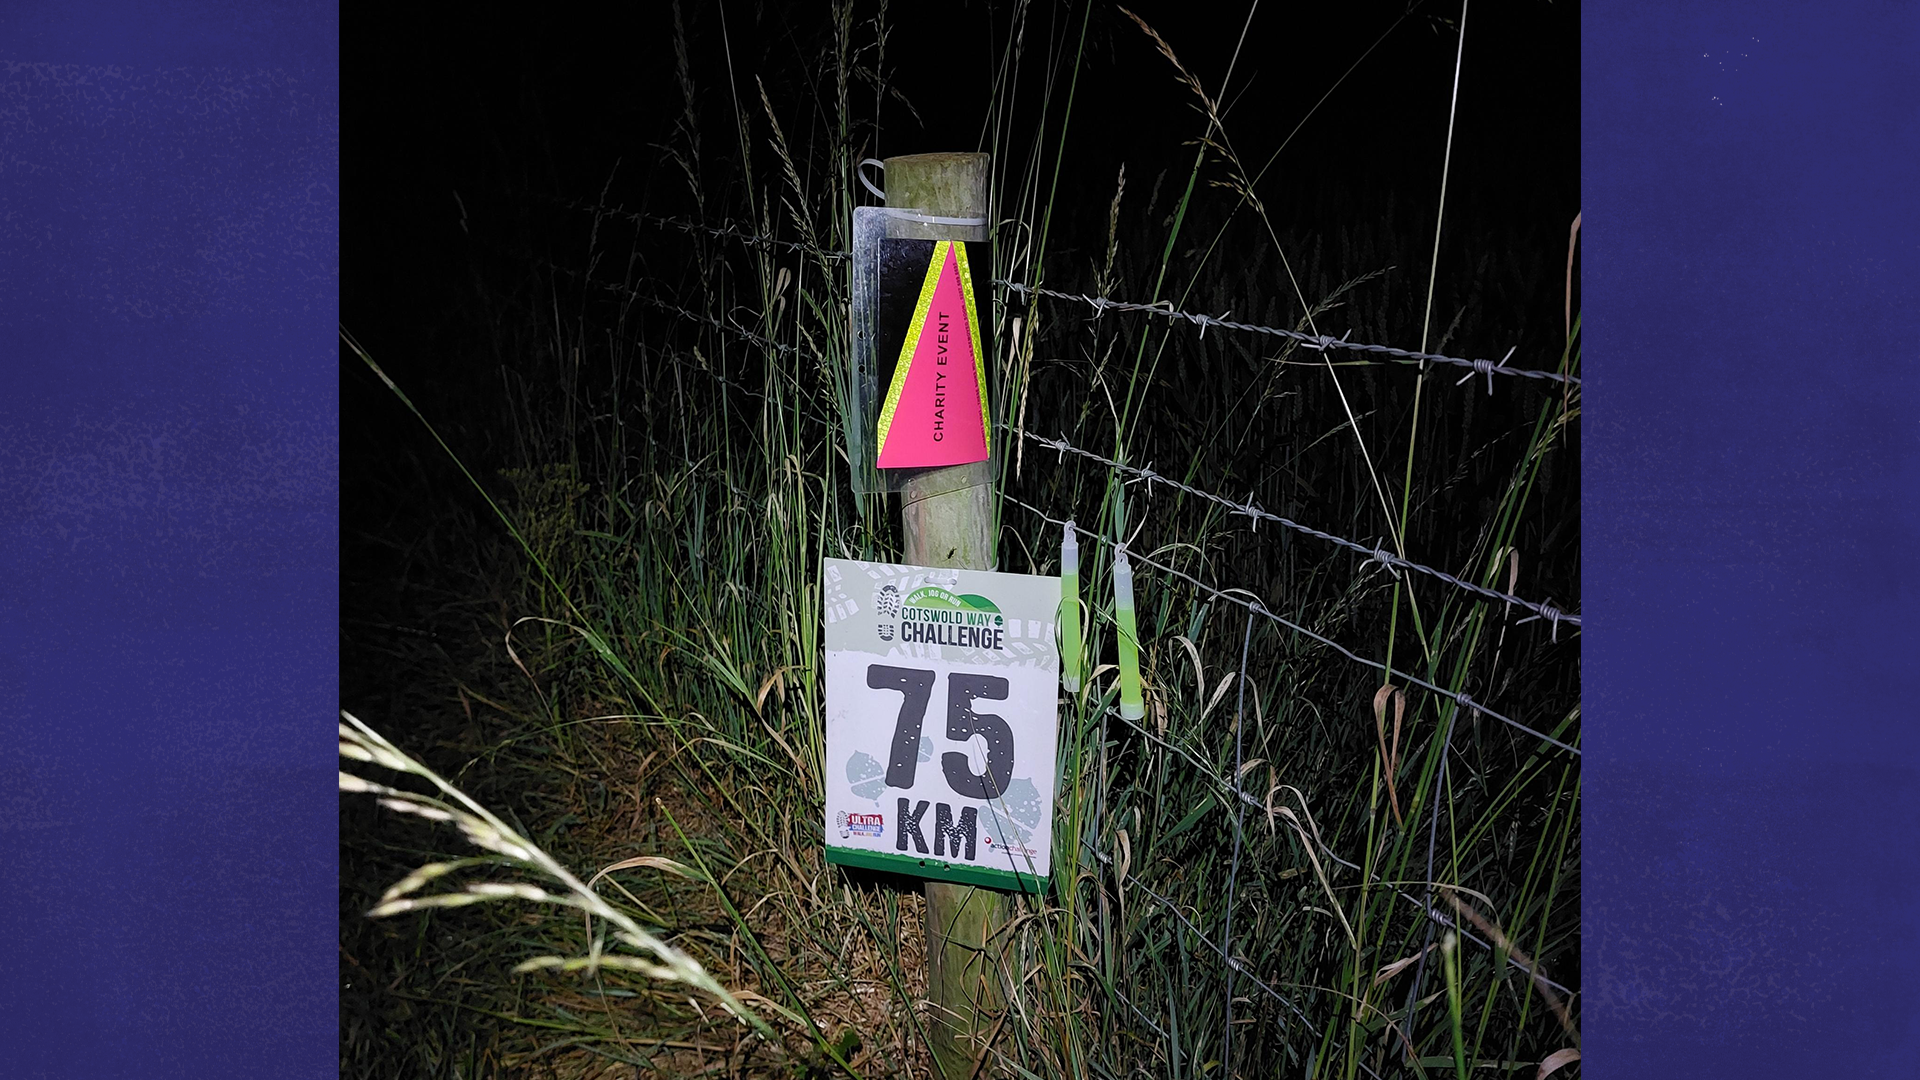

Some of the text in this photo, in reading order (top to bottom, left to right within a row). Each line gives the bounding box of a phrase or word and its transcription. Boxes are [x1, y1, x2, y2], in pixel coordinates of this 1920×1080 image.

[933, 312, 950, 442] CHARITY EVENT
[908, 590, 928, 605] WALK,
[939, 592, 948, 601] OR
[947, 596, 962, 608] RUN
[901, 606, 992, 627] COTSWOLD WAY
[901, 621, 1004, 651] CHALLENGE
[866, 664, 1015, 800] 75
[851, 815, 881, 826] ULTRA
[896, 797, 979, 861] KM
